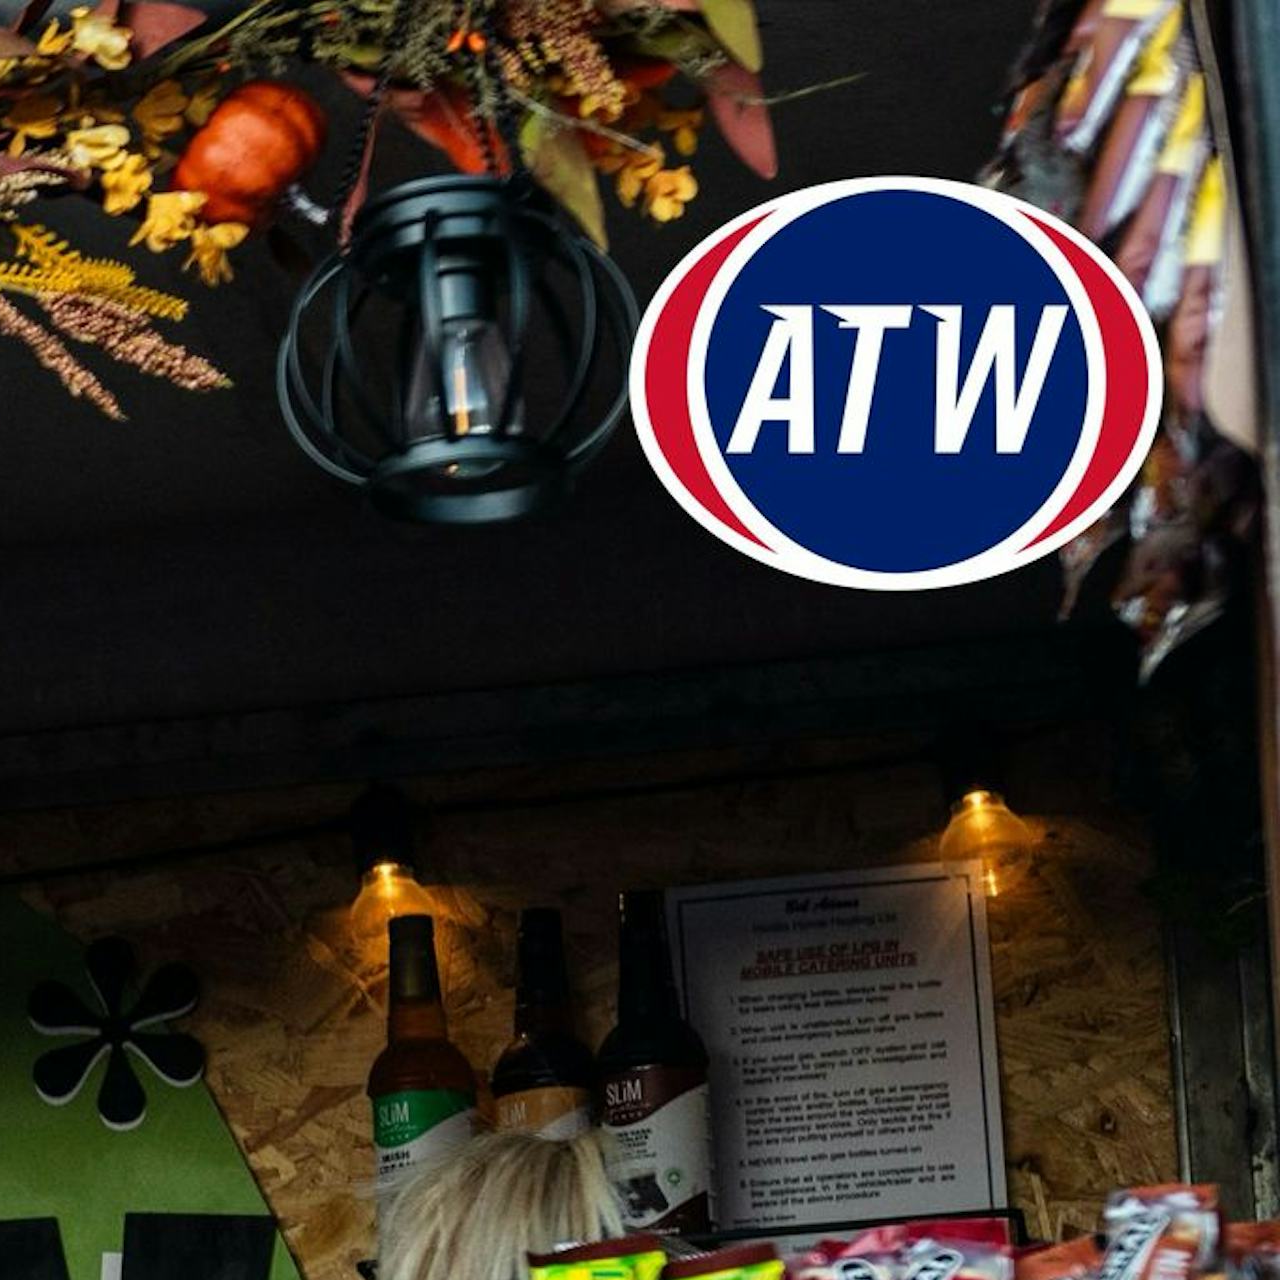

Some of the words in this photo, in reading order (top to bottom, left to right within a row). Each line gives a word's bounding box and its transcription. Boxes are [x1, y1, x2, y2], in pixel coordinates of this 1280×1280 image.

[741, 961, 796, 977] MOBILE
[800, 954, 870, 972] CATERING
[875, 950, 918, 966] UNITS
